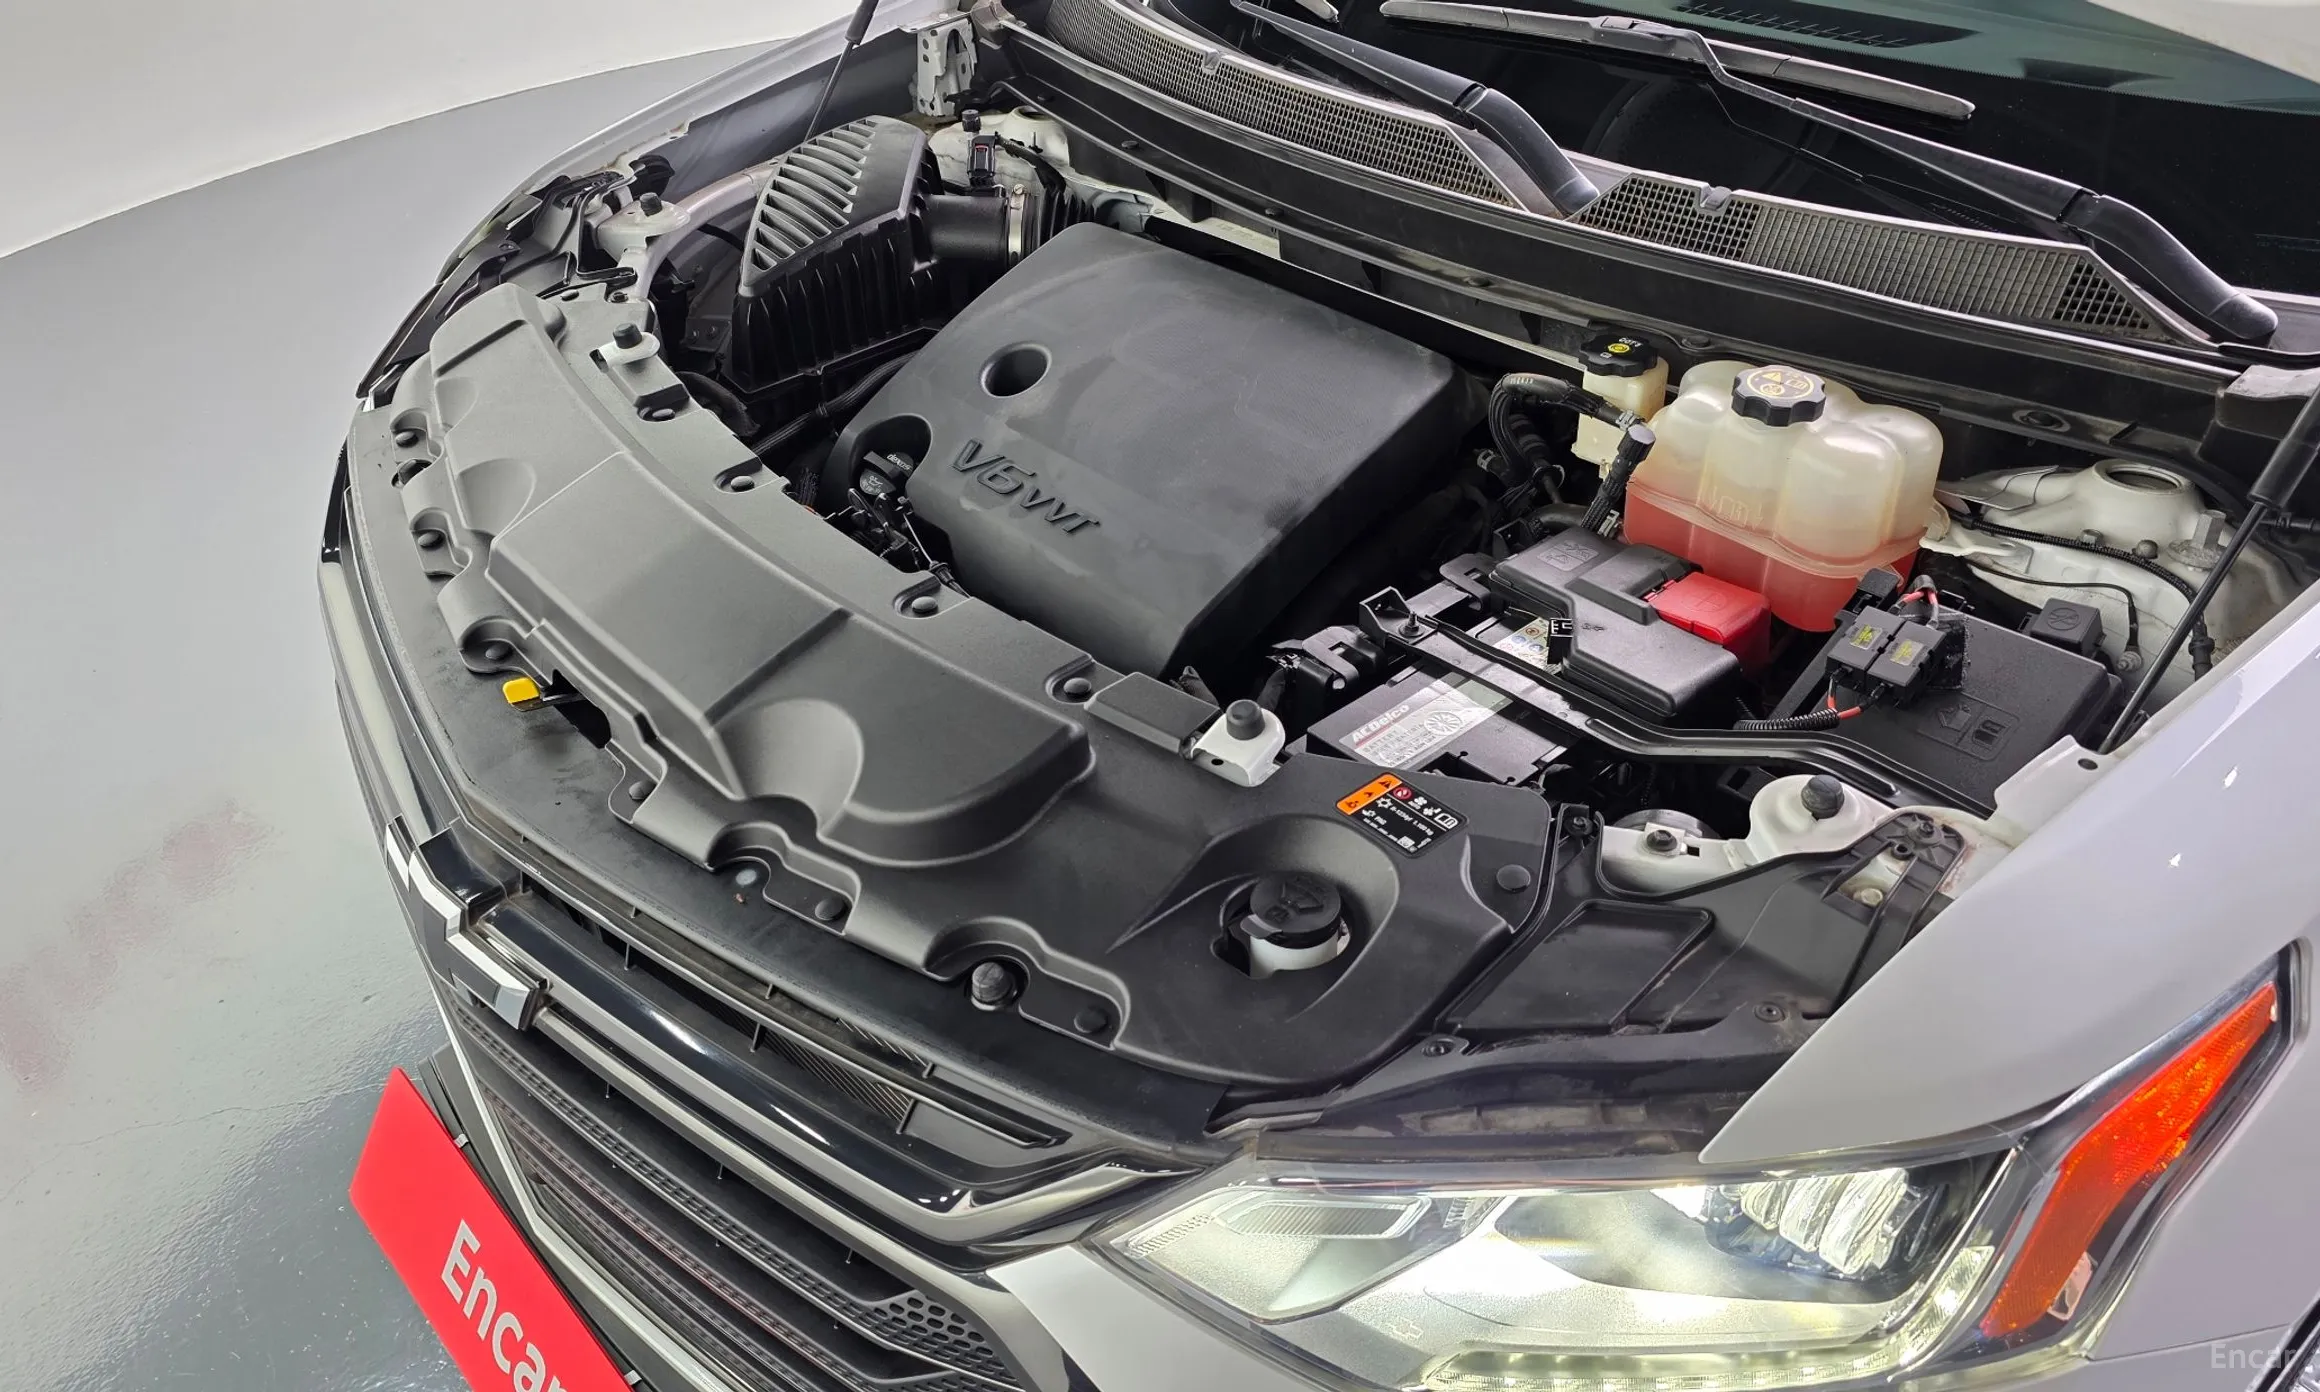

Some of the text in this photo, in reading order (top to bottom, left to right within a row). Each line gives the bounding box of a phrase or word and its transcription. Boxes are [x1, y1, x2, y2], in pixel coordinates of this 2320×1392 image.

[886, 453, 912, 471] dexos
[951, 438, 1037, 495] V6
[1352, 704, 1410, 744] ACDelco
